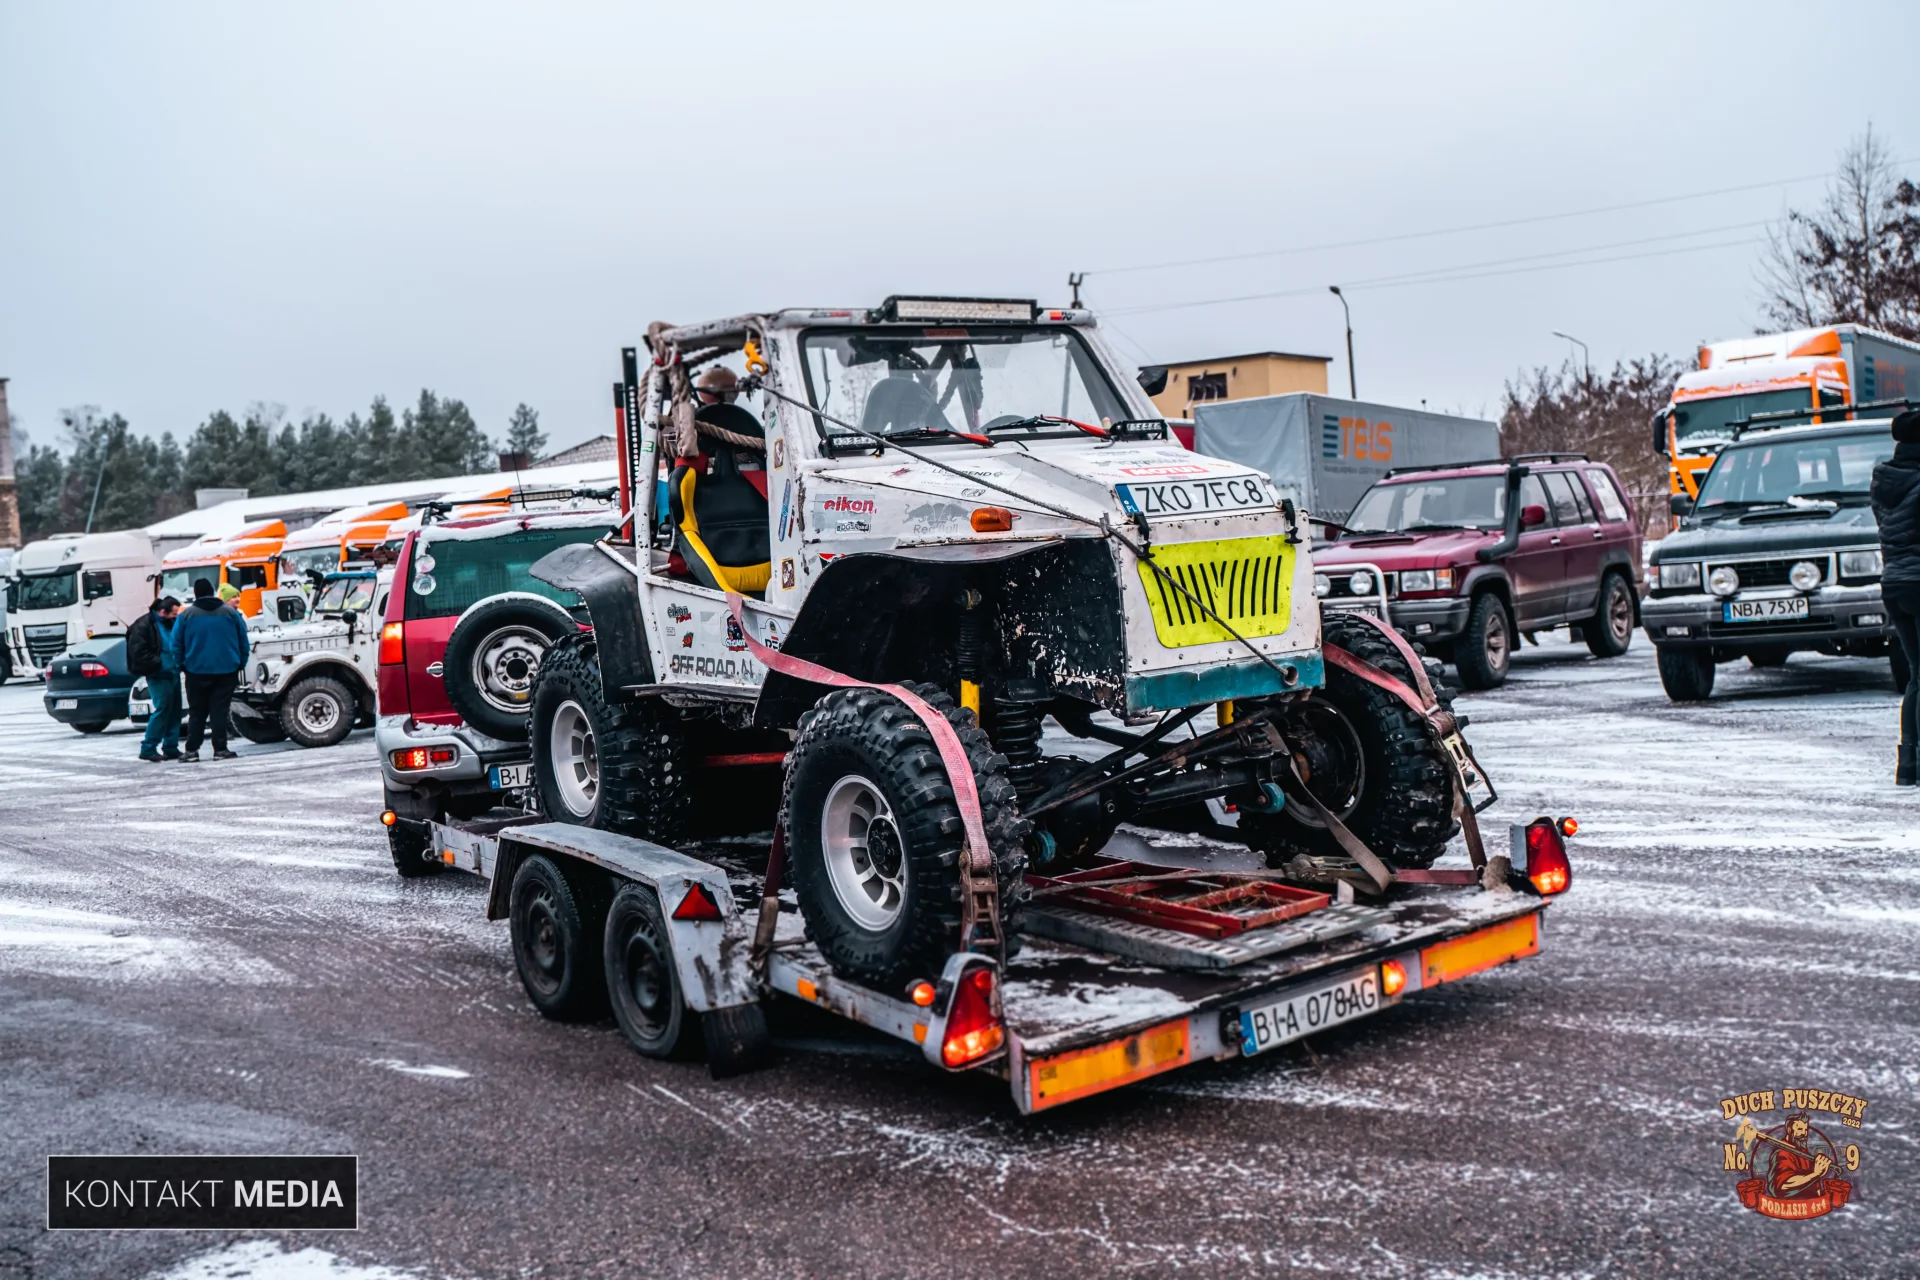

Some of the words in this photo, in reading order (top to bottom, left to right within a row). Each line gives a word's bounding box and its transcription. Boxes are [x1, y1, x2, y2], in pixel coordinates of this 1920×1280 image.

[1132, 465, 1203, 476] MOTUL
[823, 496, 874, 512] eikon
[1134, 485, 1193, 513] ZKO
[1193, 479, 1264, 508] 7FC8
[913, 523, 933, 535] Red
[1732, 603, 1764, 618] NBA
[1769, 599, 1806, 615] 75XP
[1253, 1001, 1301, 1045] BIA
[1306, 978, 1376, 1027] 078AG
